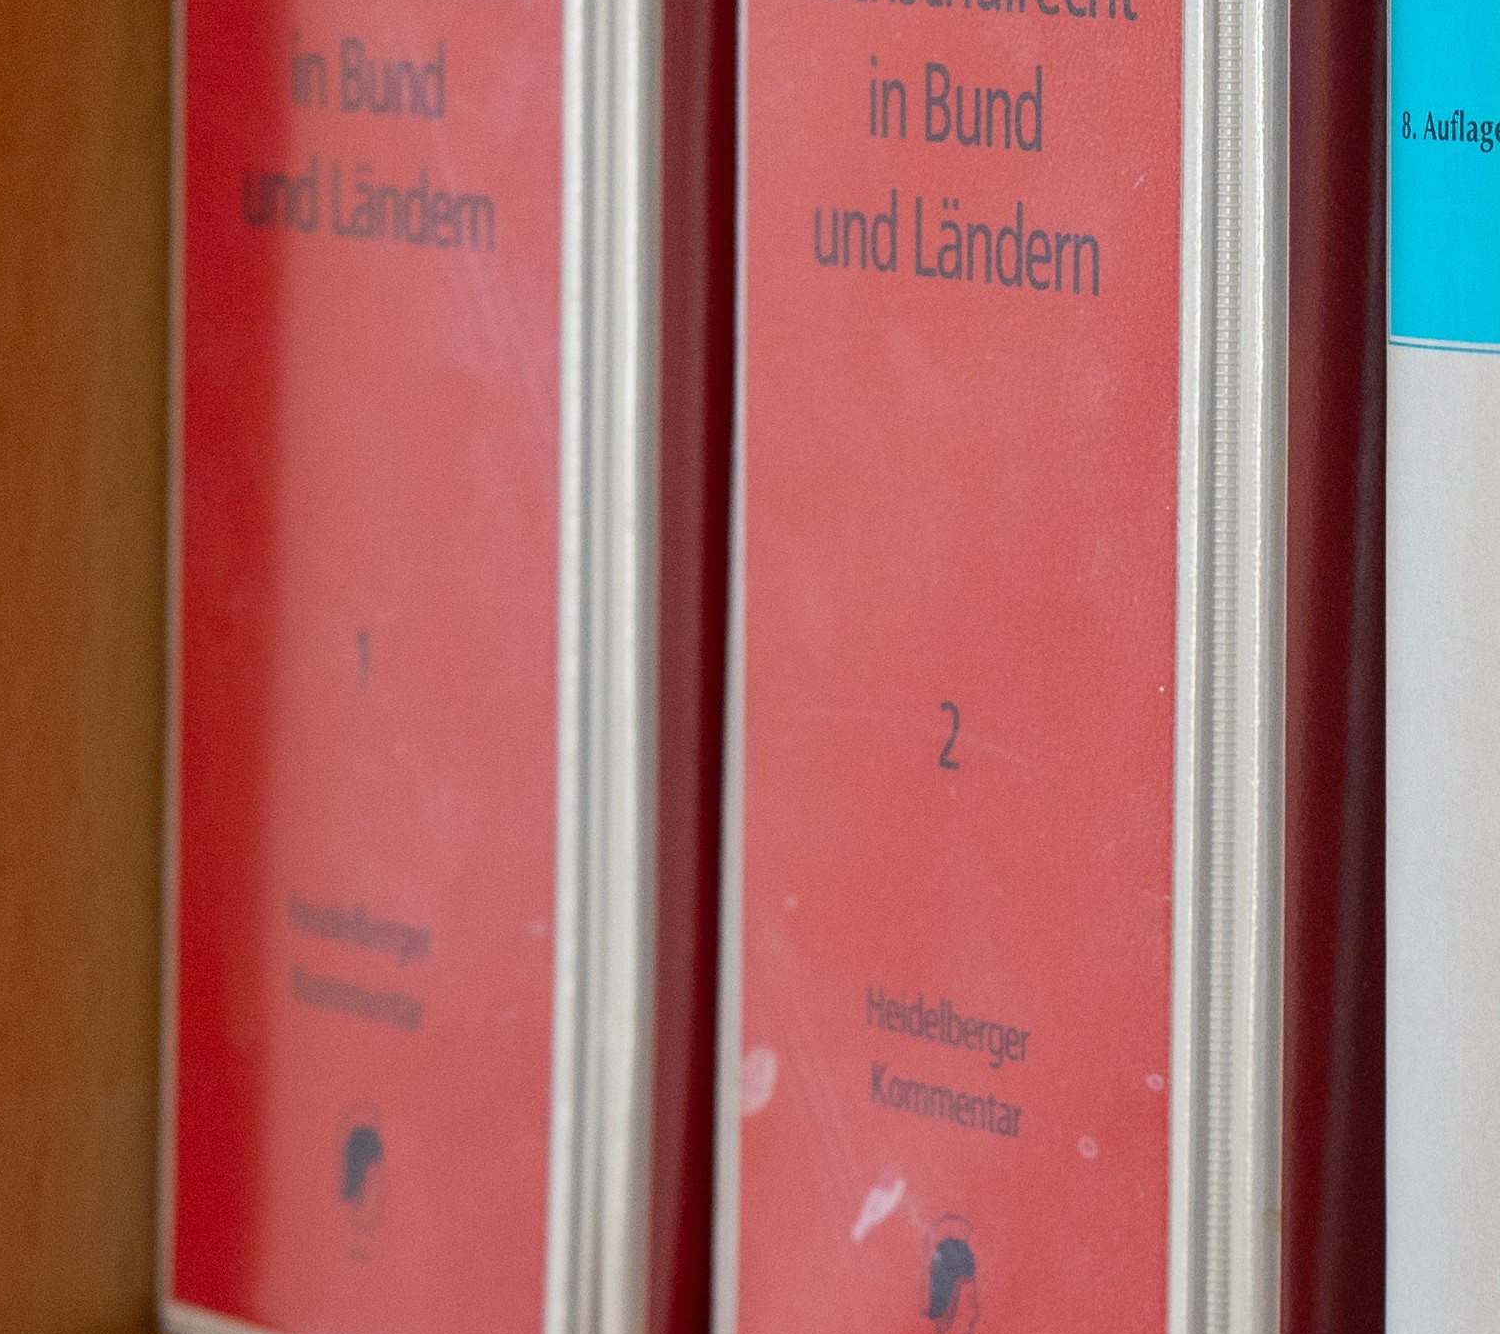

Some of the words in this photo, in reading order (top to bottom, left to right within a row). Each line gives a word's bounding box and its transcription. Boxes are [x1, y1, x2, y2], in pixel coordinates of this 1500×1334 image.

[290, 30, 328, 109] in
[340, 35, 445, 119] Bund
[869, 55, 908, 139] in
[924, 62, 1043, 152] Bund
[1401, 111, 1418, 140] 8.
[242, 157, 319, 233] und
[331, 161, 496, 252] Ländern
[814, 189, 898, 273] und
[914, 194, 1101, 297] Ländern
[938, 700, 960, 770] 2
[866, 985, 1031, 1068] Heidelberger
[871, 1060, 1024, 1138] Kommentar
